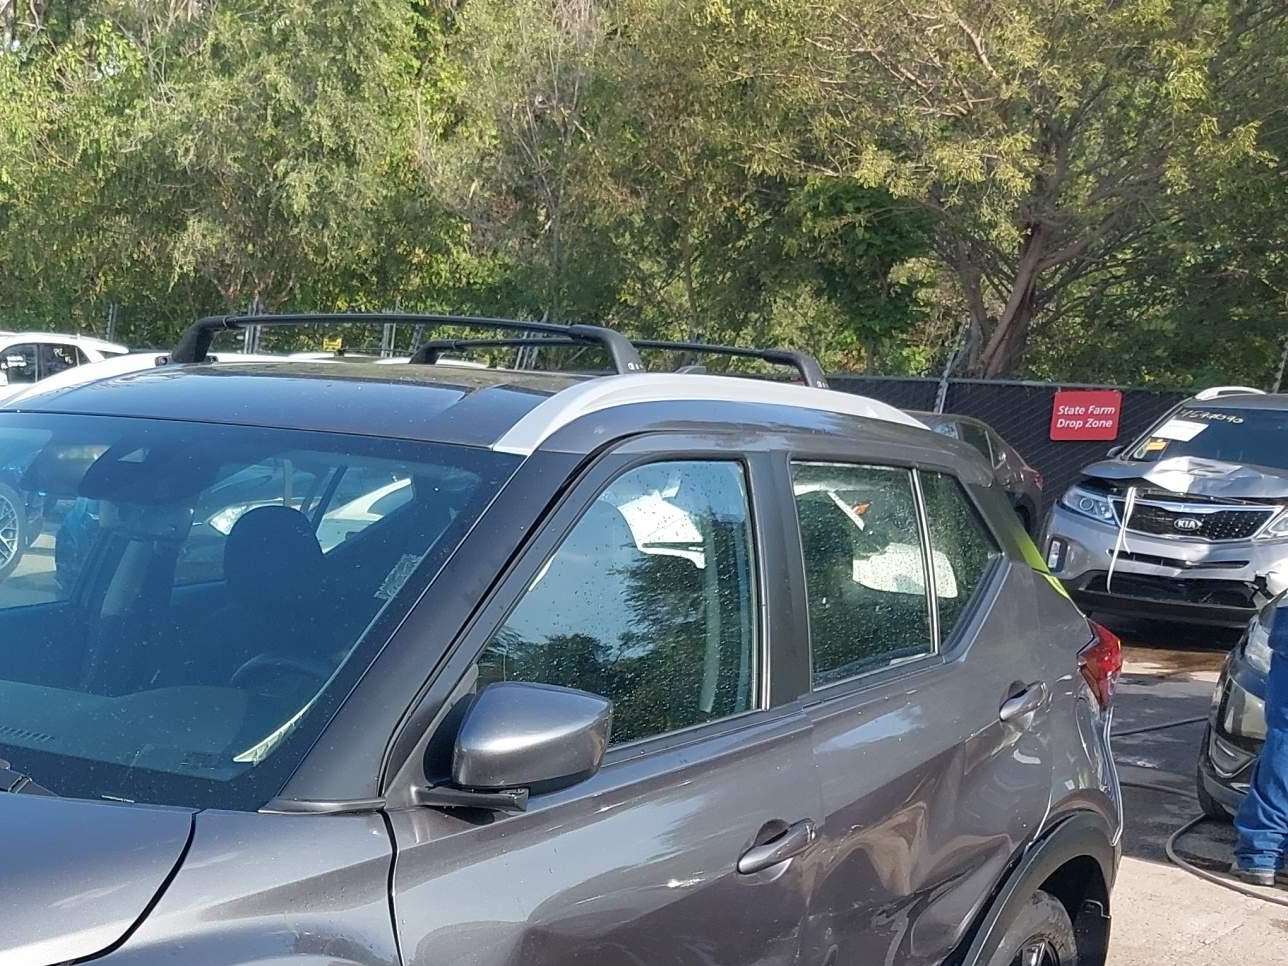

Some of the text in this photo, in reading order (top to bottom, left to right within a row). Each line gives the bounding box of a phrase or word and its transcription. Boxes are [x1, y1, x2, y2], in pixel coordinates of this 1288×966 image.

[1057, 404, 1116, 415] State Farm
[1056, 418, 1113, 430] Drop Zone
